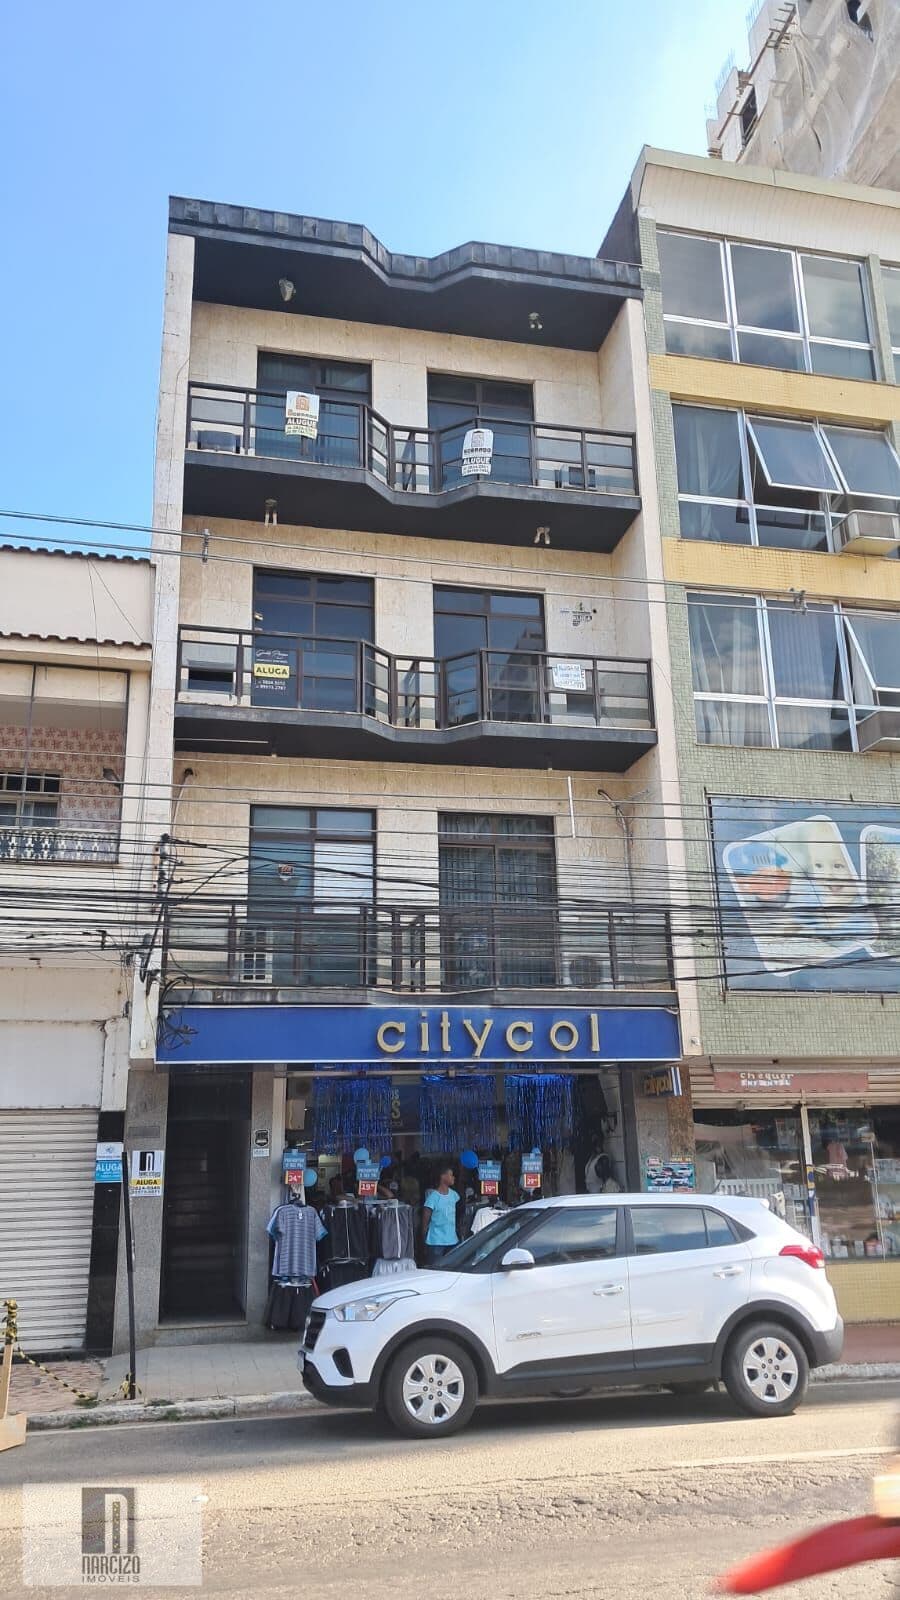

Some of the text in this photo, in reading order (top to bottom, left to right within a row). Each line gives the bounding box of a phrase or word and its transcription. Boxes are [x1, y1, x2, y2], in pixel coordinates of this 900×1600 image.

[287, 418, 317, 428] ALUGUE
[463, 457, 490, 465] ALUGUE
[256, 666, 288, 675] ALUGA
[376, 1010, 601, 1058] citycol
